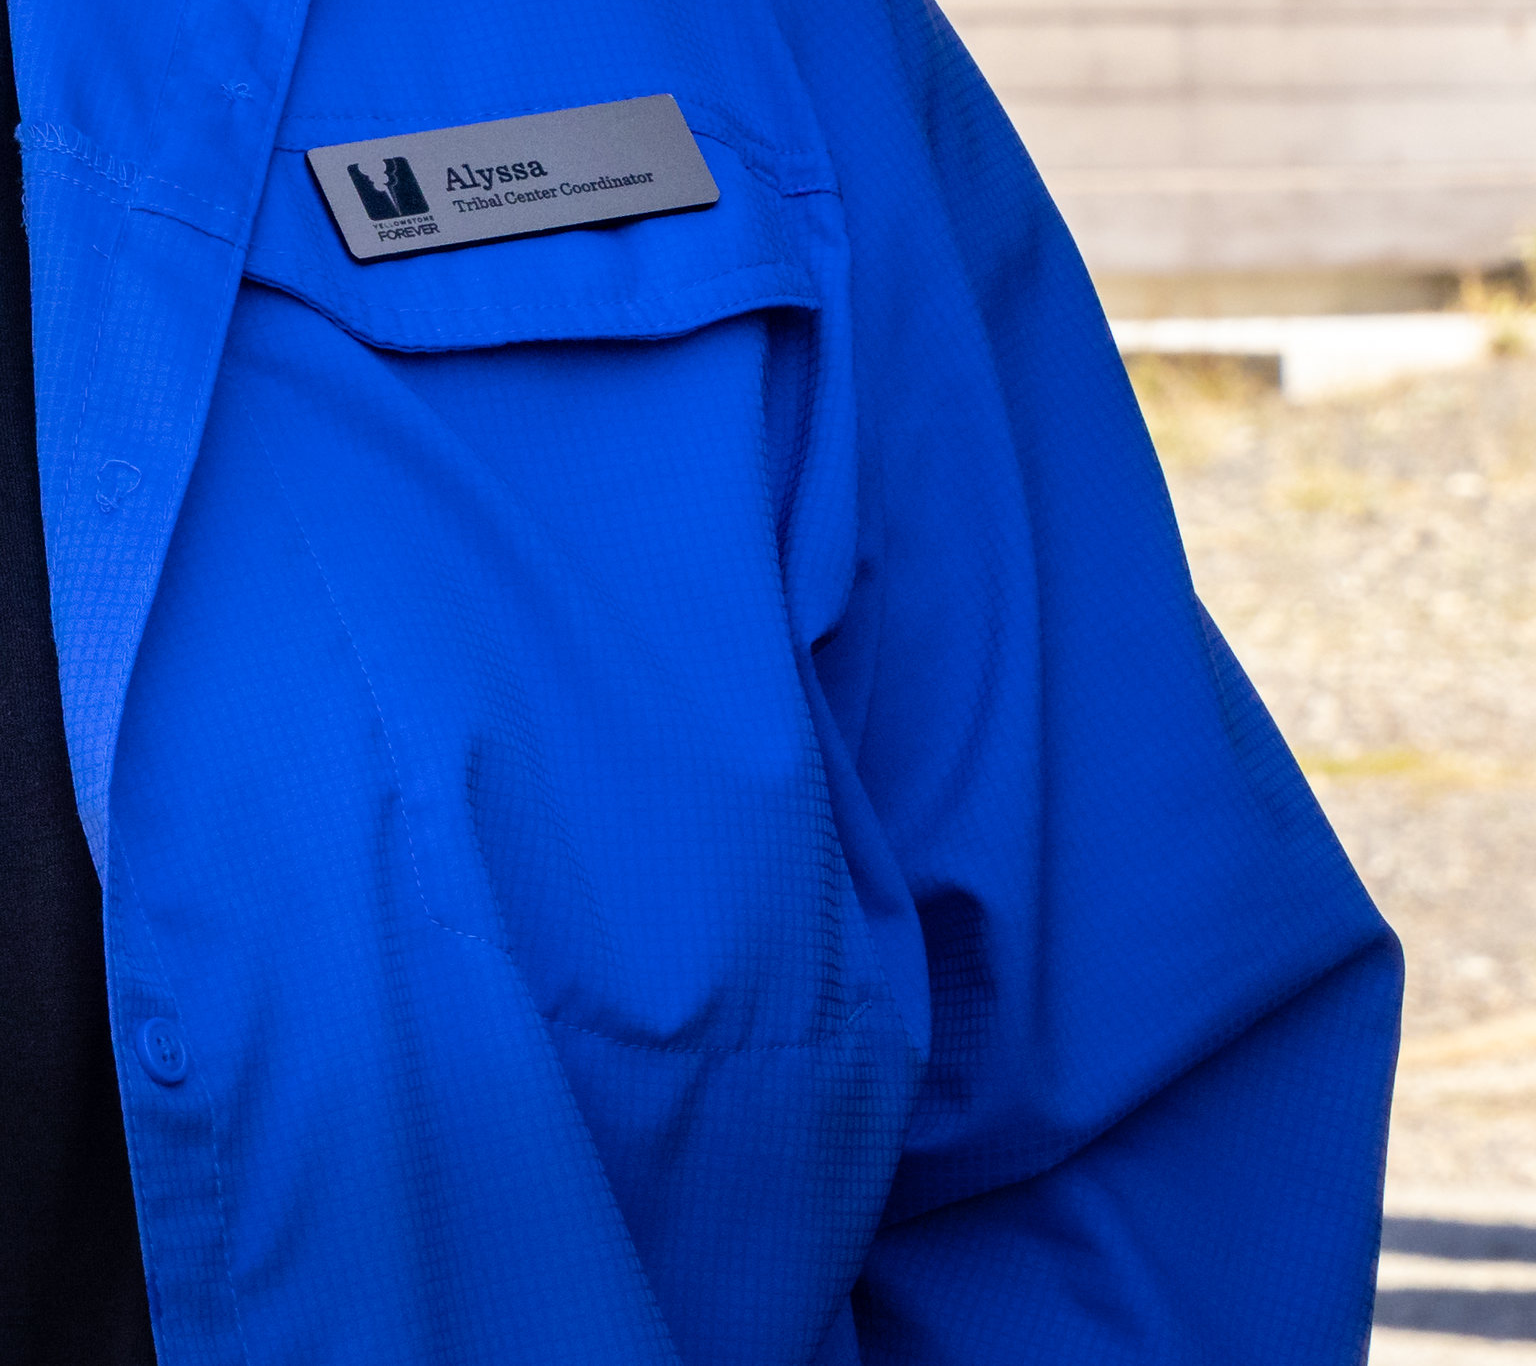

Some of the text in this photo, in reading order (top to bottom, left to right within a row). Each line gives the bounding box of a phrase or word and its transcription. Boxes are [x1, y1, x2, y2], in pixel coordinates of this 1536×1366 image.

[446, 160, 548, 191] Alyssa
[453, 172, 654, 213] Tribal Center Coordinator
[378, 223, 440, 242] FOREVER
